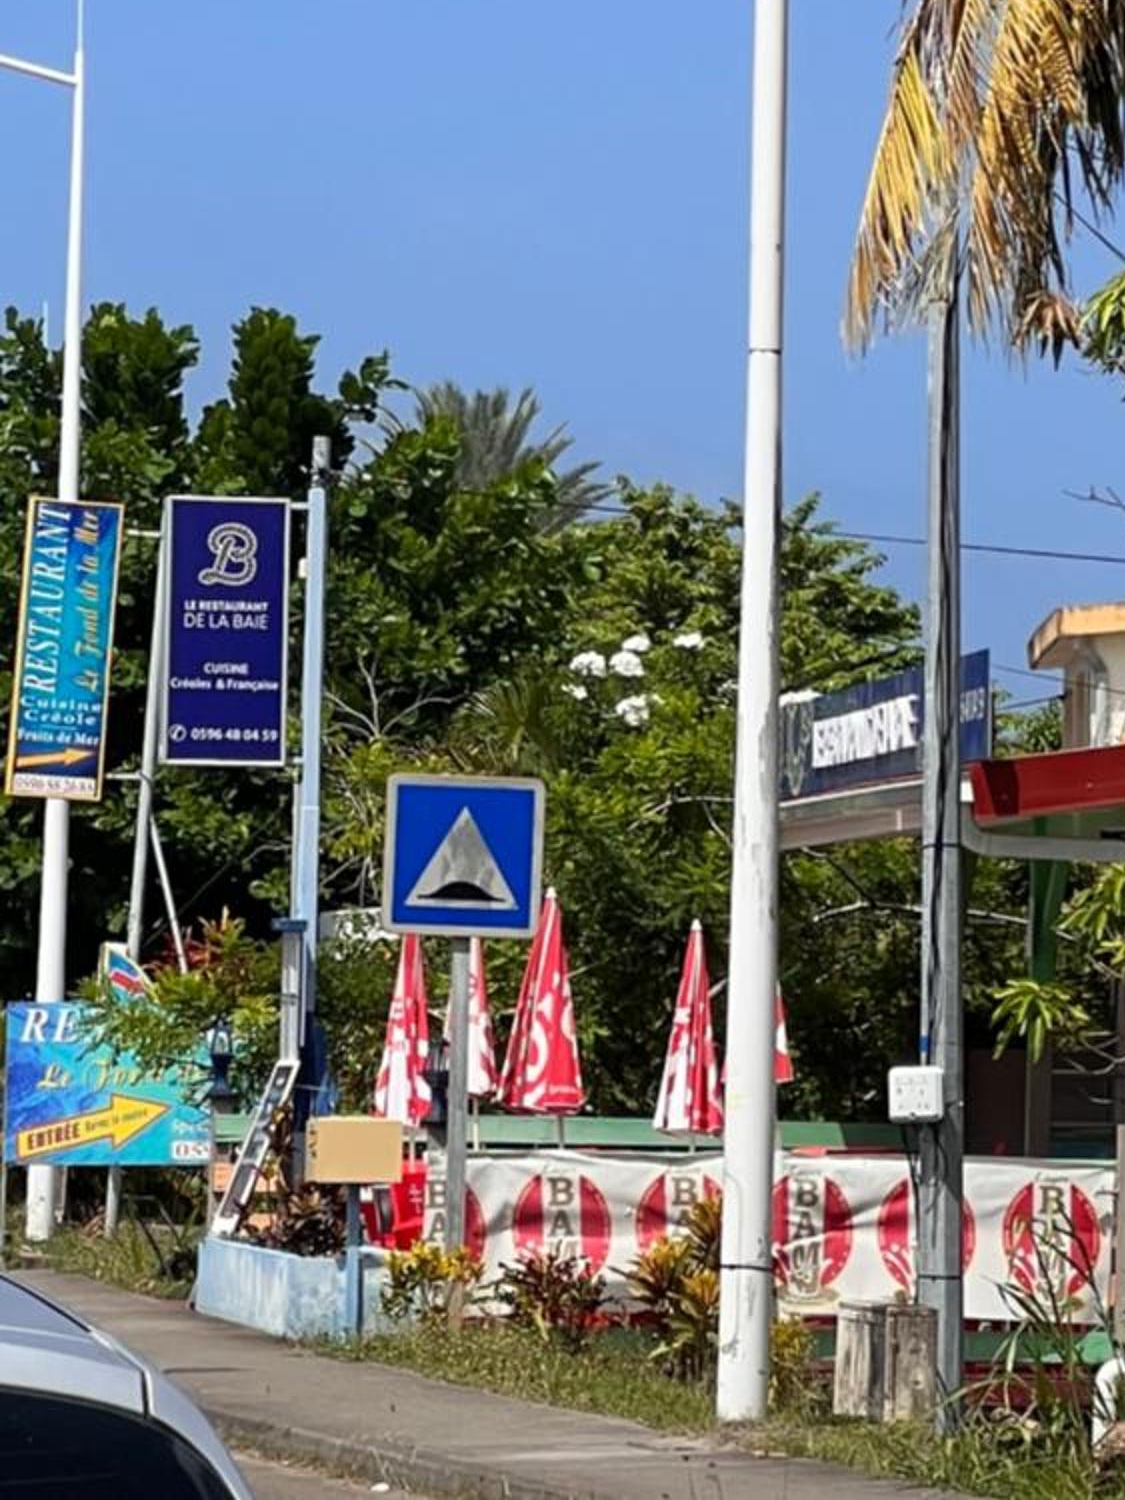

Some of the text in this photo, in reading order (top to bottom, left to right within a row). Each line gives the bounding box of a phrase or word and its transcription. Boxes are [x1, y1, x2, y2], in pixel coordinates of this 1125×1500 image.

[23, 503, 71, 692] RESTAURANT
[184, 601, 269, 612] LE RESTAURANT
[183, 612, 268, 630] DE LA BAIE
[203, 662, 249, 675] CUISINE
[74, 670, 99, 693] Le
[216, 678, 225, 690] &
[21, 695, 100, 713] Cuisine
[24, 709, 97, 725] Créole
[190, 727, 278, 741] 0596 48 04 59
[27, 1121, 80, 1151] ENTRÉE
